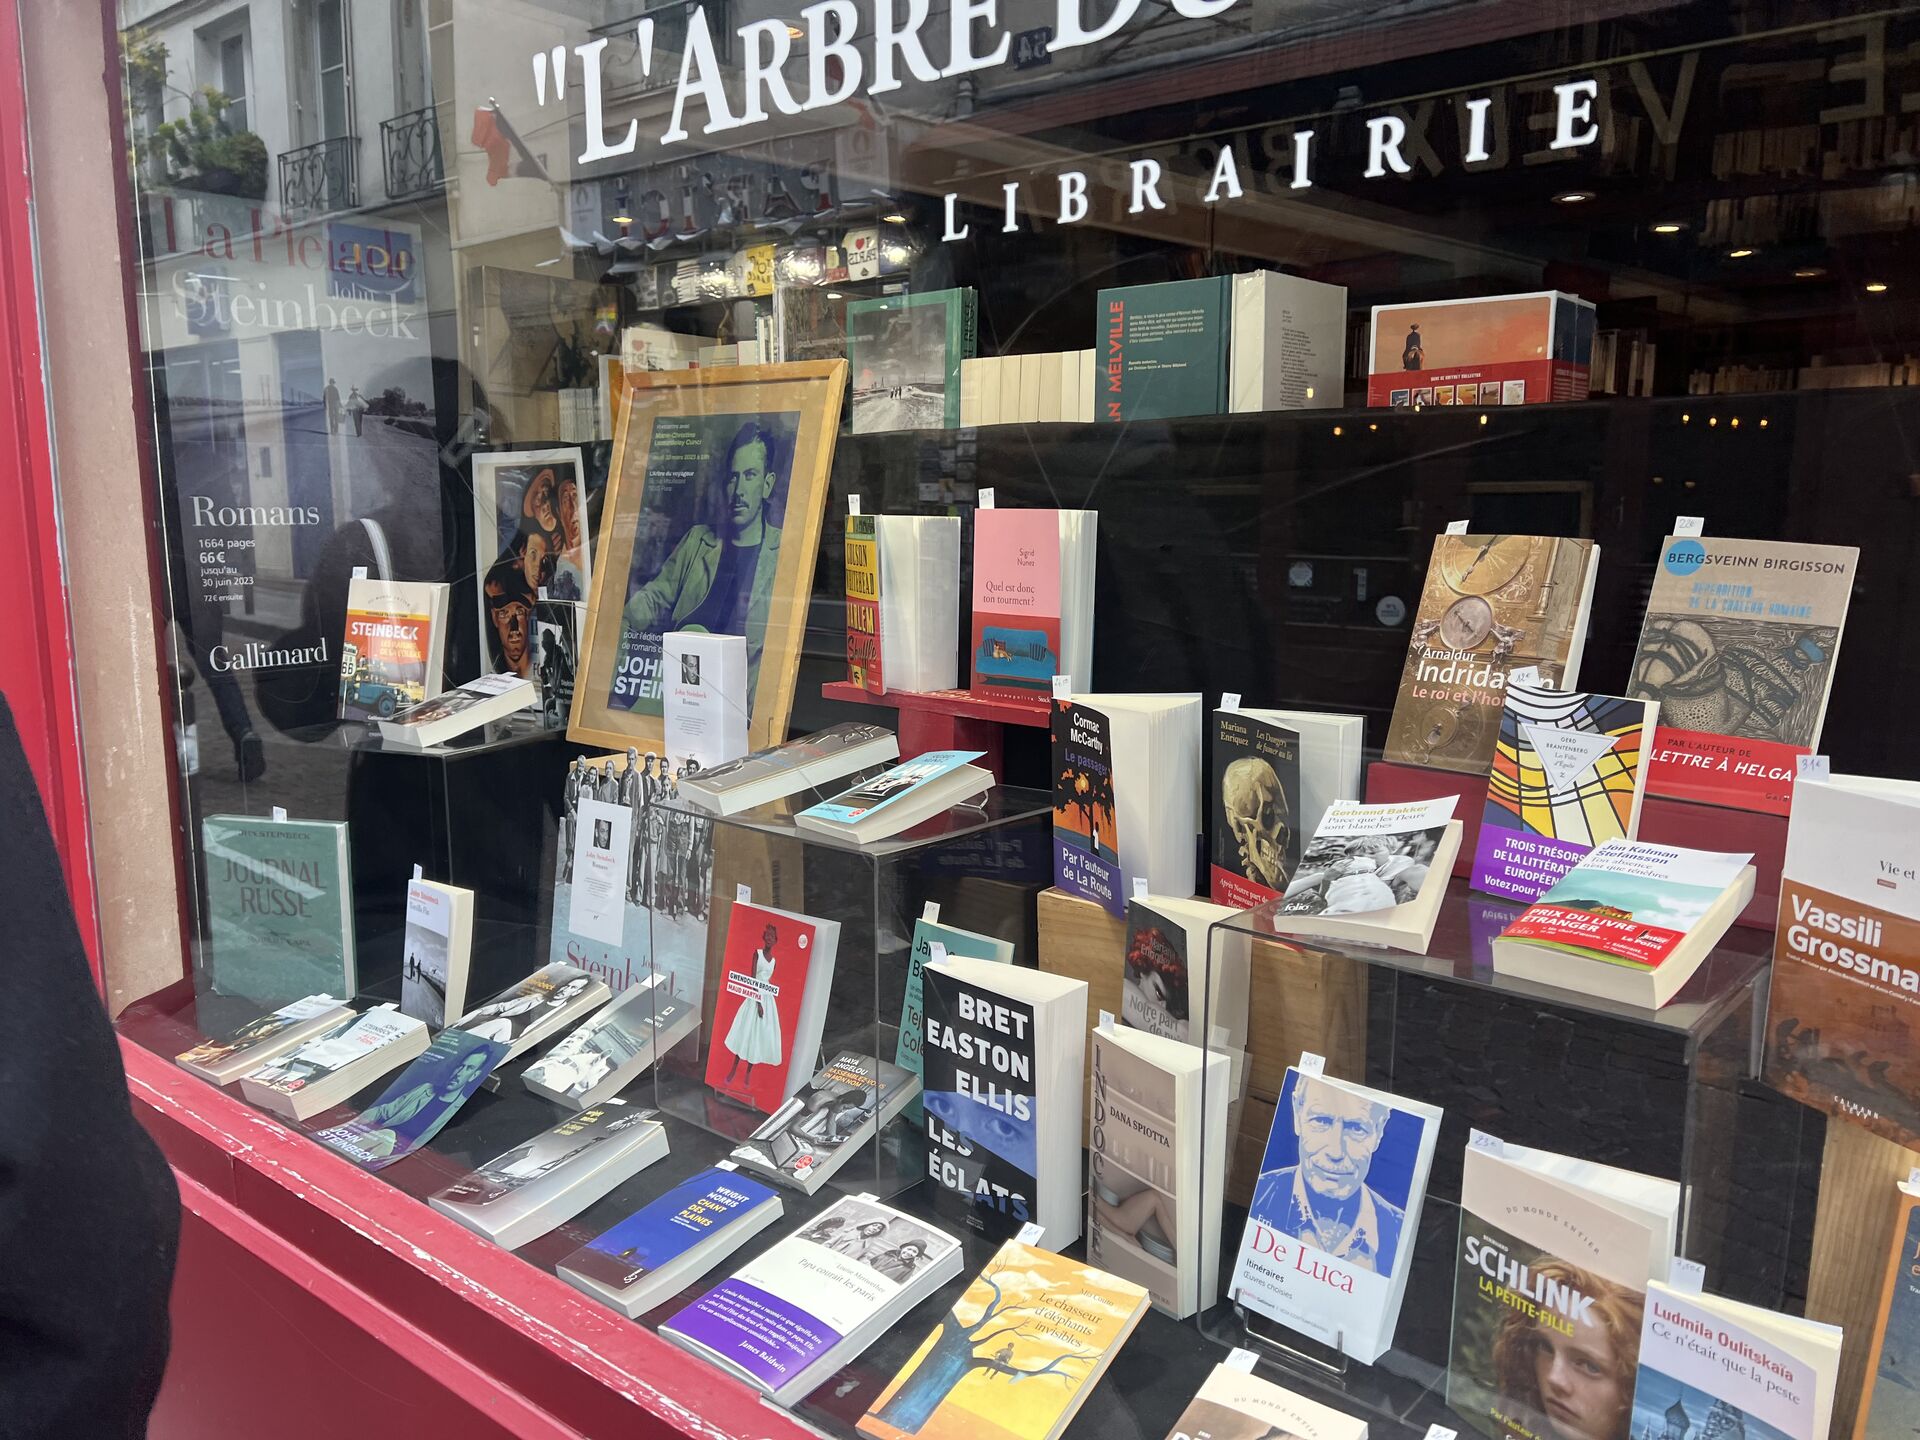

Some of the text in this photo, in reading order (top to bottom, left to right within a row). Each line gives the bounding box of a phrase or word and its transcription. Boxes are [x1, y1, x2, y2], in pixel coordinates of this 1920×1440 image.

[942, 80, 1598, 243] LIBRAIRIE
[172, 270, 419, 340] Steinbeck
[1108, 300, 1124, 393] MELVILLE
[188, 495, 321, 527] Romans
[199, 539, 256, 550] 1664 pages
[1019, 547, 1035, 558] Sigrid
[200, 566, 238, 577] jusqu'au
[1668, 552, 1846, 575] BERGSVEINN BIRGISSON
[203, 576, 255, 589] 30 juin 2023
[985, 580, 1035, 594] Quel est donc
[983, 595, 997, 604] ton
[351, 621, 419, 641] STEINBECK
[623, 630, 638, 640] pour
[209, 637, 329, 672] Gallimard
[631, 643, 657, 653] romans
[1422, 649, 1476, 662] Arnaldur
[341, 661, 354, 676] 66
[1412, 685, 1469, 702] Le roi et
[1073, 712, 1100, 734] Cormac
[1220, 720, 1247, 734] Mariana
[1070, 728, 1103, 755] McCarthy
[1220, 731, 1249, 747] Enriquez
[1668, 738, 1751, 757] PAR L'AUTEUR DE
[1064, 747, 1108, 776] Le passager
[1650, 750, 1791, 782] LETTRE À HELGA
[1327, 813, 1425, 825] Parce que les fleurs
[1331, 805, 1430, 817] Gerbrand Bakker
[1347, 822, 1392, 831] blanches
[1493, 848, 1523, 864] DE LA
[1505, 837, 1586, 864] TROIS TRÉSORS
[1629, 845, 1678, 859] Kalman
[222, 855, 327, 889] JOURNAL
[1062, 847, 1110, 882] Par l'auteur
[1606, 865, 1625, 874] que
[1611, 858, 1654, 869] absence
[1879, 860, 1916, 881] Vie et
[1062, 866, 1075, 880] de
[1076, 871, 1089, 886] La
[1090, 877, 1113, 901] Route
[1484, 875, 1536, 898] Votez pour
[239, 886, 313, 918] RUSSE
[1283, 902, 1313, 912] folio
[1529, 908, 1638, 932] PRIX DU LIVRE
[1791, 893, 1882, 948] Vassili
[1634, 939, 1663, 951] Point
[727, 983, 762, 1001] MAUD MARTHA
[729, 972, 779, 995] GWENDOLYN BROOKS
[958, 991, 1029, 1040] BRET
[1129, 995, 1179, 1033] Notre part
[838, 1056, 860, 1067] MAYA
[926, 1017, 1030, 1083] EASTON
[832, 1061, 869, 1077] ANGELOU
[955, 1068, 1031, 1122] ELLIS
[329, 1127, 364, 1144] JOHN
[928, 1116, 974, 1157] LES
[1109, 1105, 1170, 1149] DANA SPIOTTA
[317, 1131, 379, 1162] STEINBECK
[715, 1186, 750, 1203] WRIGHT
[928, 1147, 1030, 1223] ÉCLATS
[687, 1203, 704, 1215] DES
[696, 1198, 728, 1214] CHANT
[705, 1191, 740, 1209] MORRIS
[678, 1209, 714, 1228] PLAINES
[1522, 1205, 1559, 1222] MONDE
[1563, 1220, 1601, 1255] ENTIER
[1245, 1257, 1285, 1284] Itinéraires
[1250, 1225, 1354, 1295] De Luca
[798, 1257, 876, 1302] Papa courait les paris
[1266, 1281, 1294, 1300] choisies
[1464, 1235, 1596, 1328] SCHLINK
[1038, 1292, 1103, 1326] Le chasseur
[1478, 1275, 1576, 1338] LA PETITE-FILLE
[1034, 1306, 1094, 1338] d'éléphants
[1034, 1321, 1083, 1349] invisibles
[1653, 1301, 1795, 1384] Ludmila Oulitskaïa
[738, 1339, 787, 1373] James Baldwin
[1651, 1320, 1801, 1406] Ce n'était que la peste
